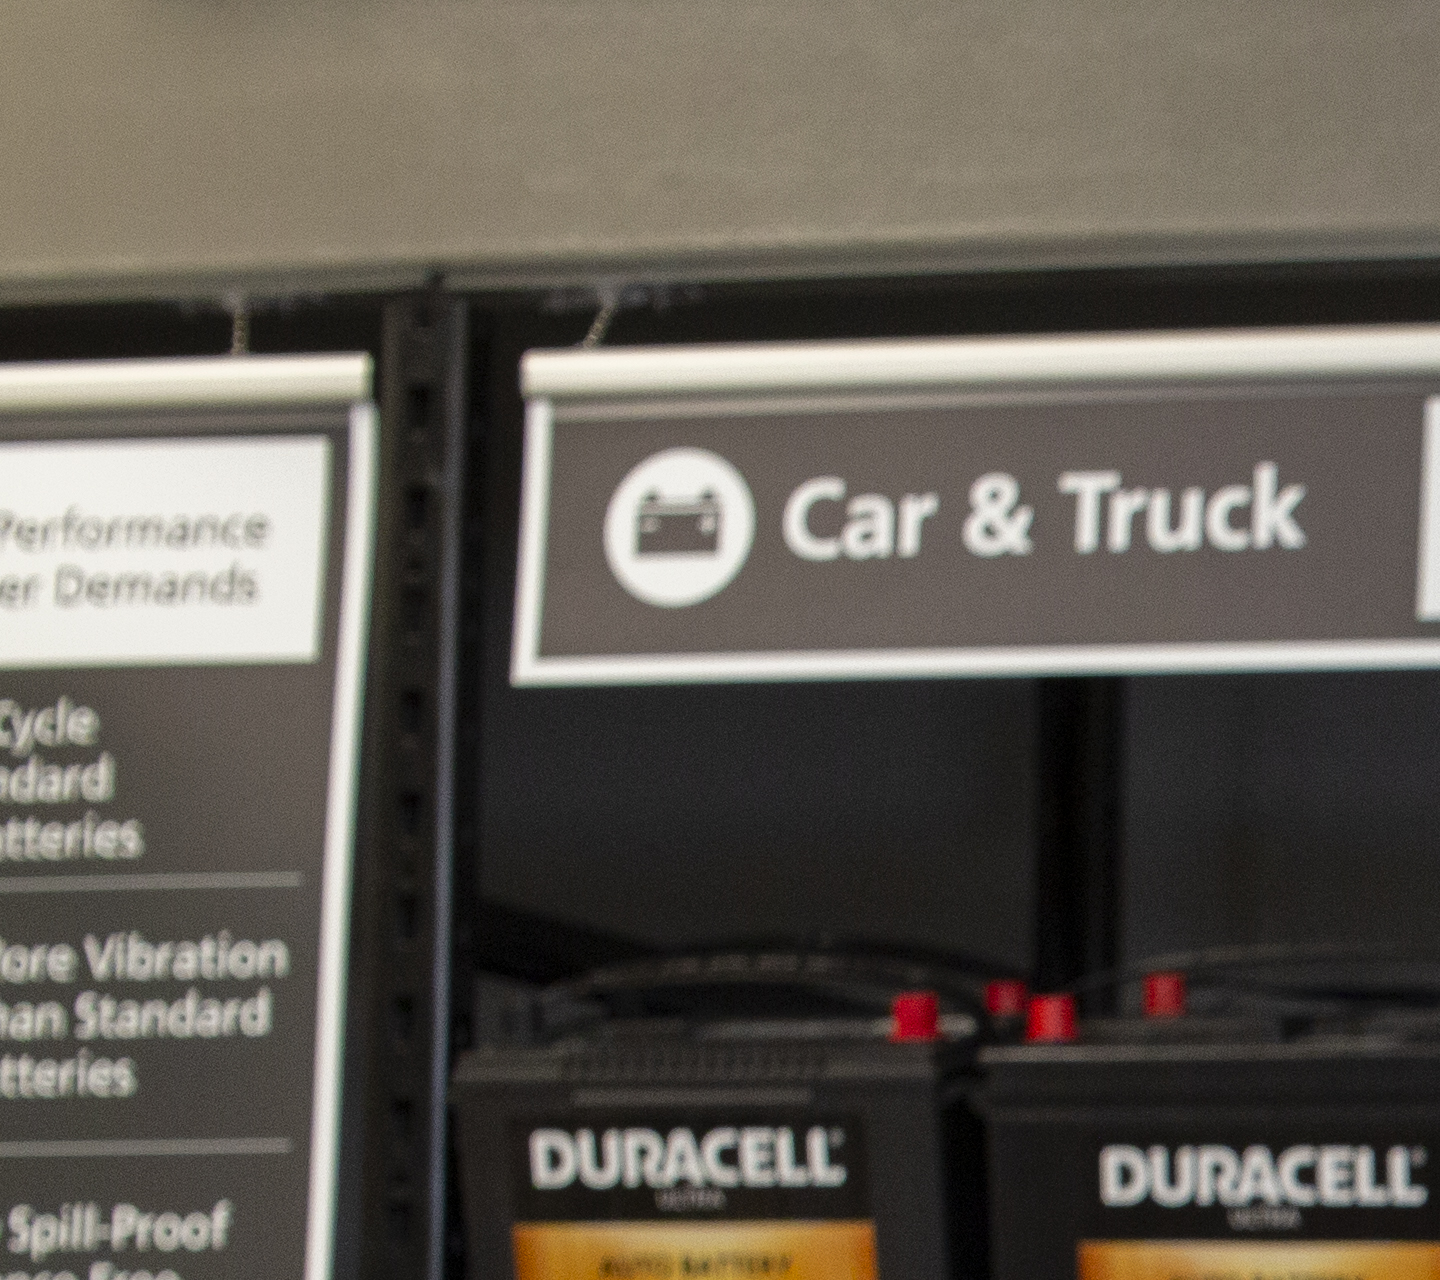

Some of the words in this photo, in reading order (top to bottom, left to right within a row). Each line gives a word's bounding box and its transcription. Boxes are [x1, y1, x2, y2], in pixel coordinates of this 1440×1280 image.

[783, 476, 938, 562] Car
[962, 470, 1035, 557] &
[1058, 461, 1307, 553] Truck
[54, 561, 260, 611] Demands
[0, 810, 144, 862] tteries
[0, 941, 77, 985] ore
[84, 929, 290, 981] Vibration
[75, 985, 273, 1040] Standard
[528, 1126, 847, 1190] DURACELL
[1099, 1144, 1428, 1209] DURACELL
[8, 1198, 234, 1263] Spill-Proof
